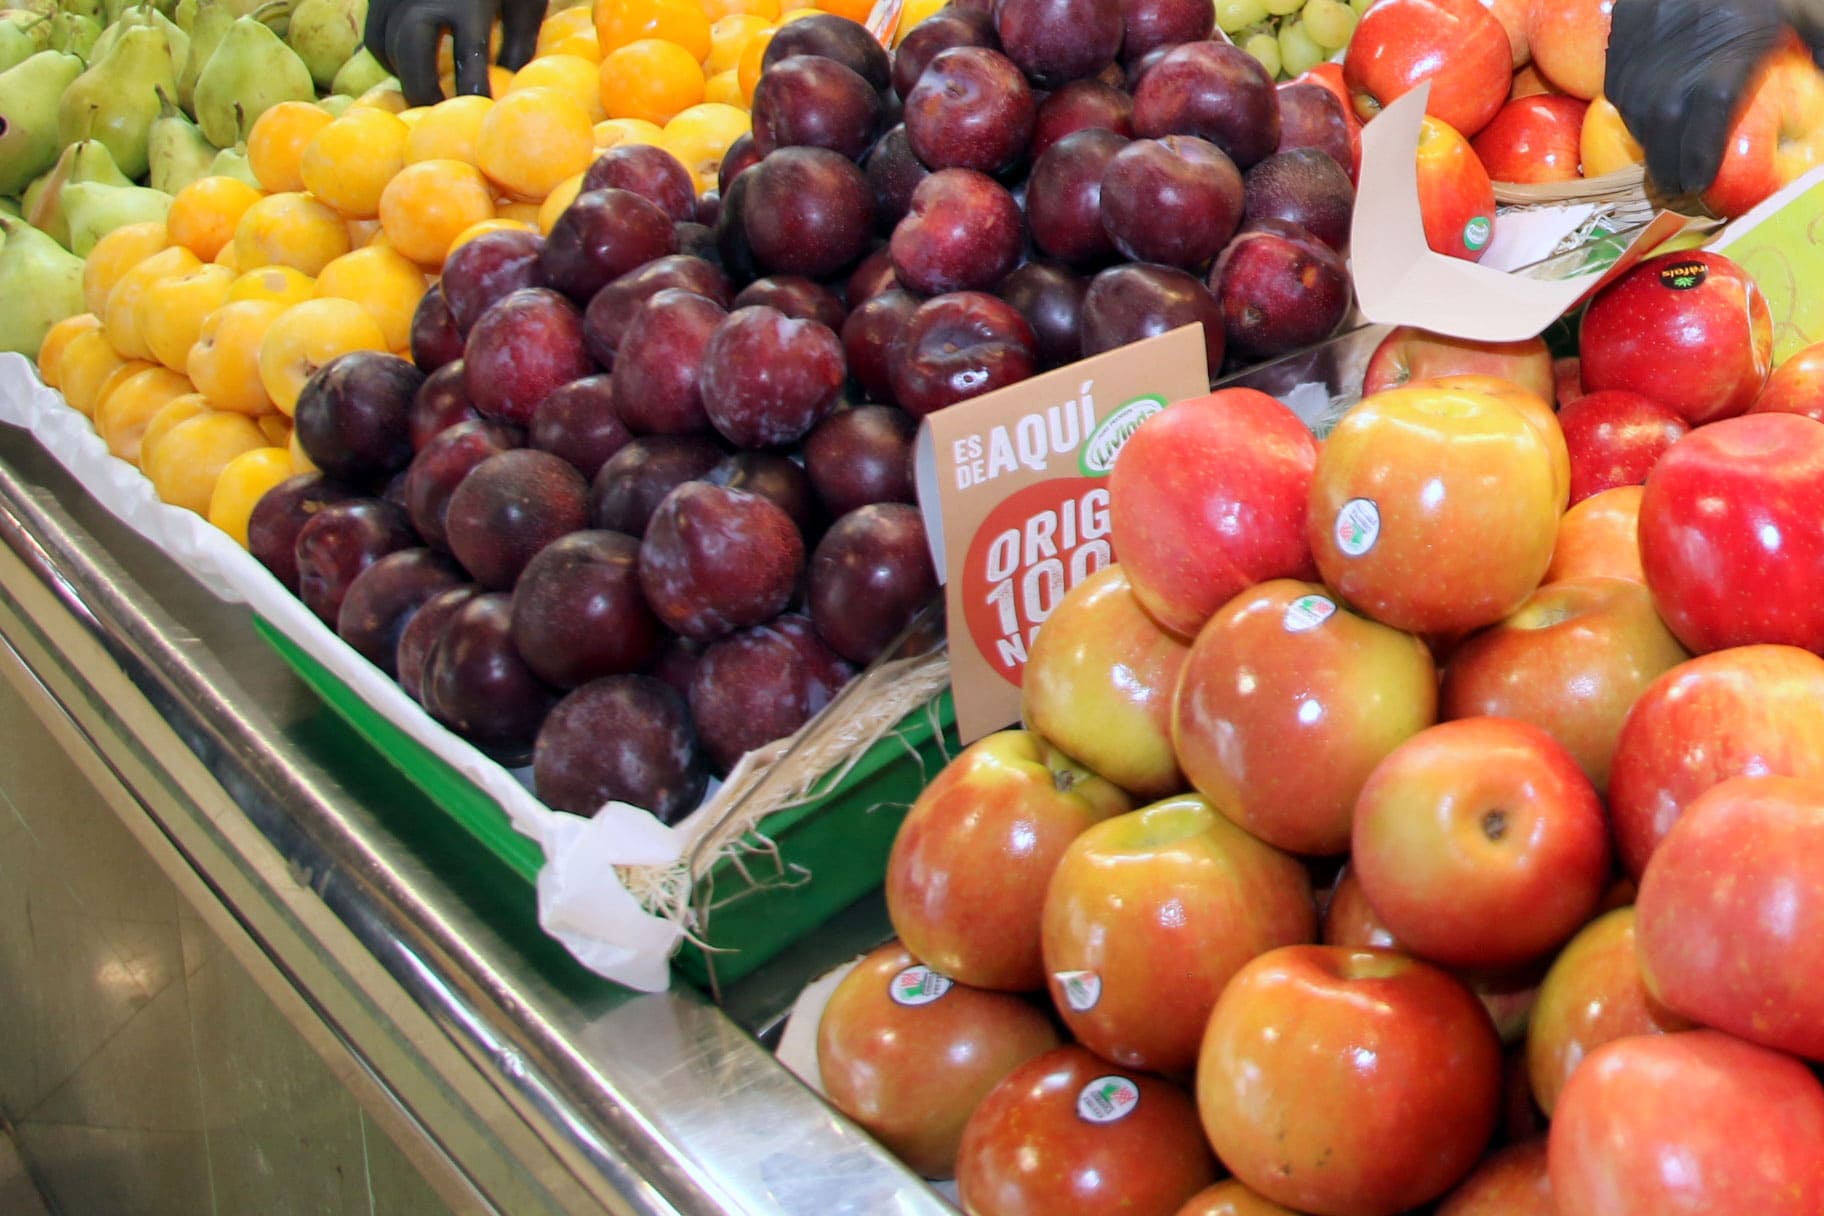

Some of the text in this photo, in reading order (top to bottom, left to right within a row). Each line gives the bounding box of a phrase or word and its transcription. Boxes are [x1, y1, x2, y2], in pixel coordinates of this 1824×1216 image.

[988, 380, 1096, 478] AQUÍ
[953, 435, 983, 465] ES
[956, 460, 988, 490] DE
